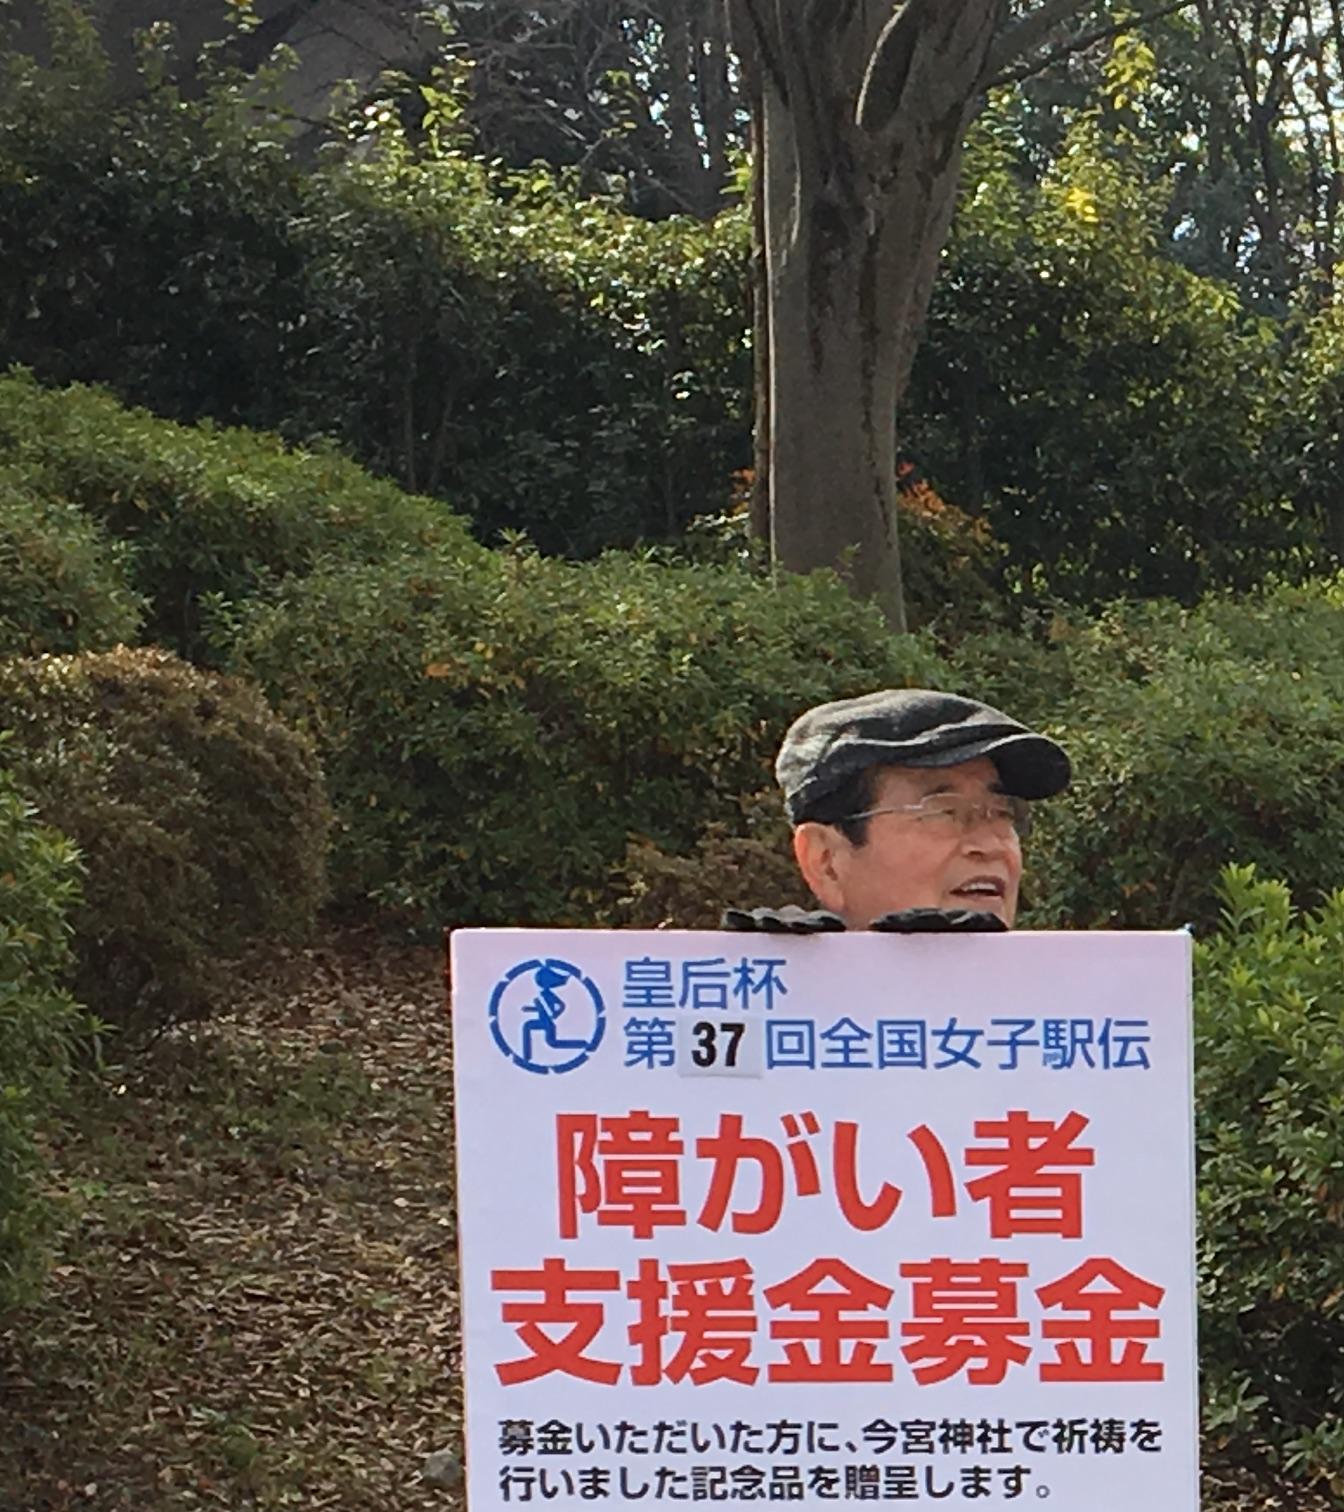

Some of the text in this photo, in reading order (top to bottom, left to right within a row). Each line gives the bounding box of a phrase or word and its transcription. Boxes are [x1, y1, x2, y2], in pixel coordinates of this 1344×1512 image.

[622, 957, 787, 1010] 皇后杯
[622, 1017, 1151, 1071] 第37回全国女子駅伝
[556, 1110, 1094, 1240] 障がい者
[491, 1258, 1165, 1385] 支援金募金
[498, 1418, 1163, 1456] 募金いただいた方に、今宮神社で祈祷を
[499, 1463, 1051, 1502] 行いました記念品を贈呈します。
